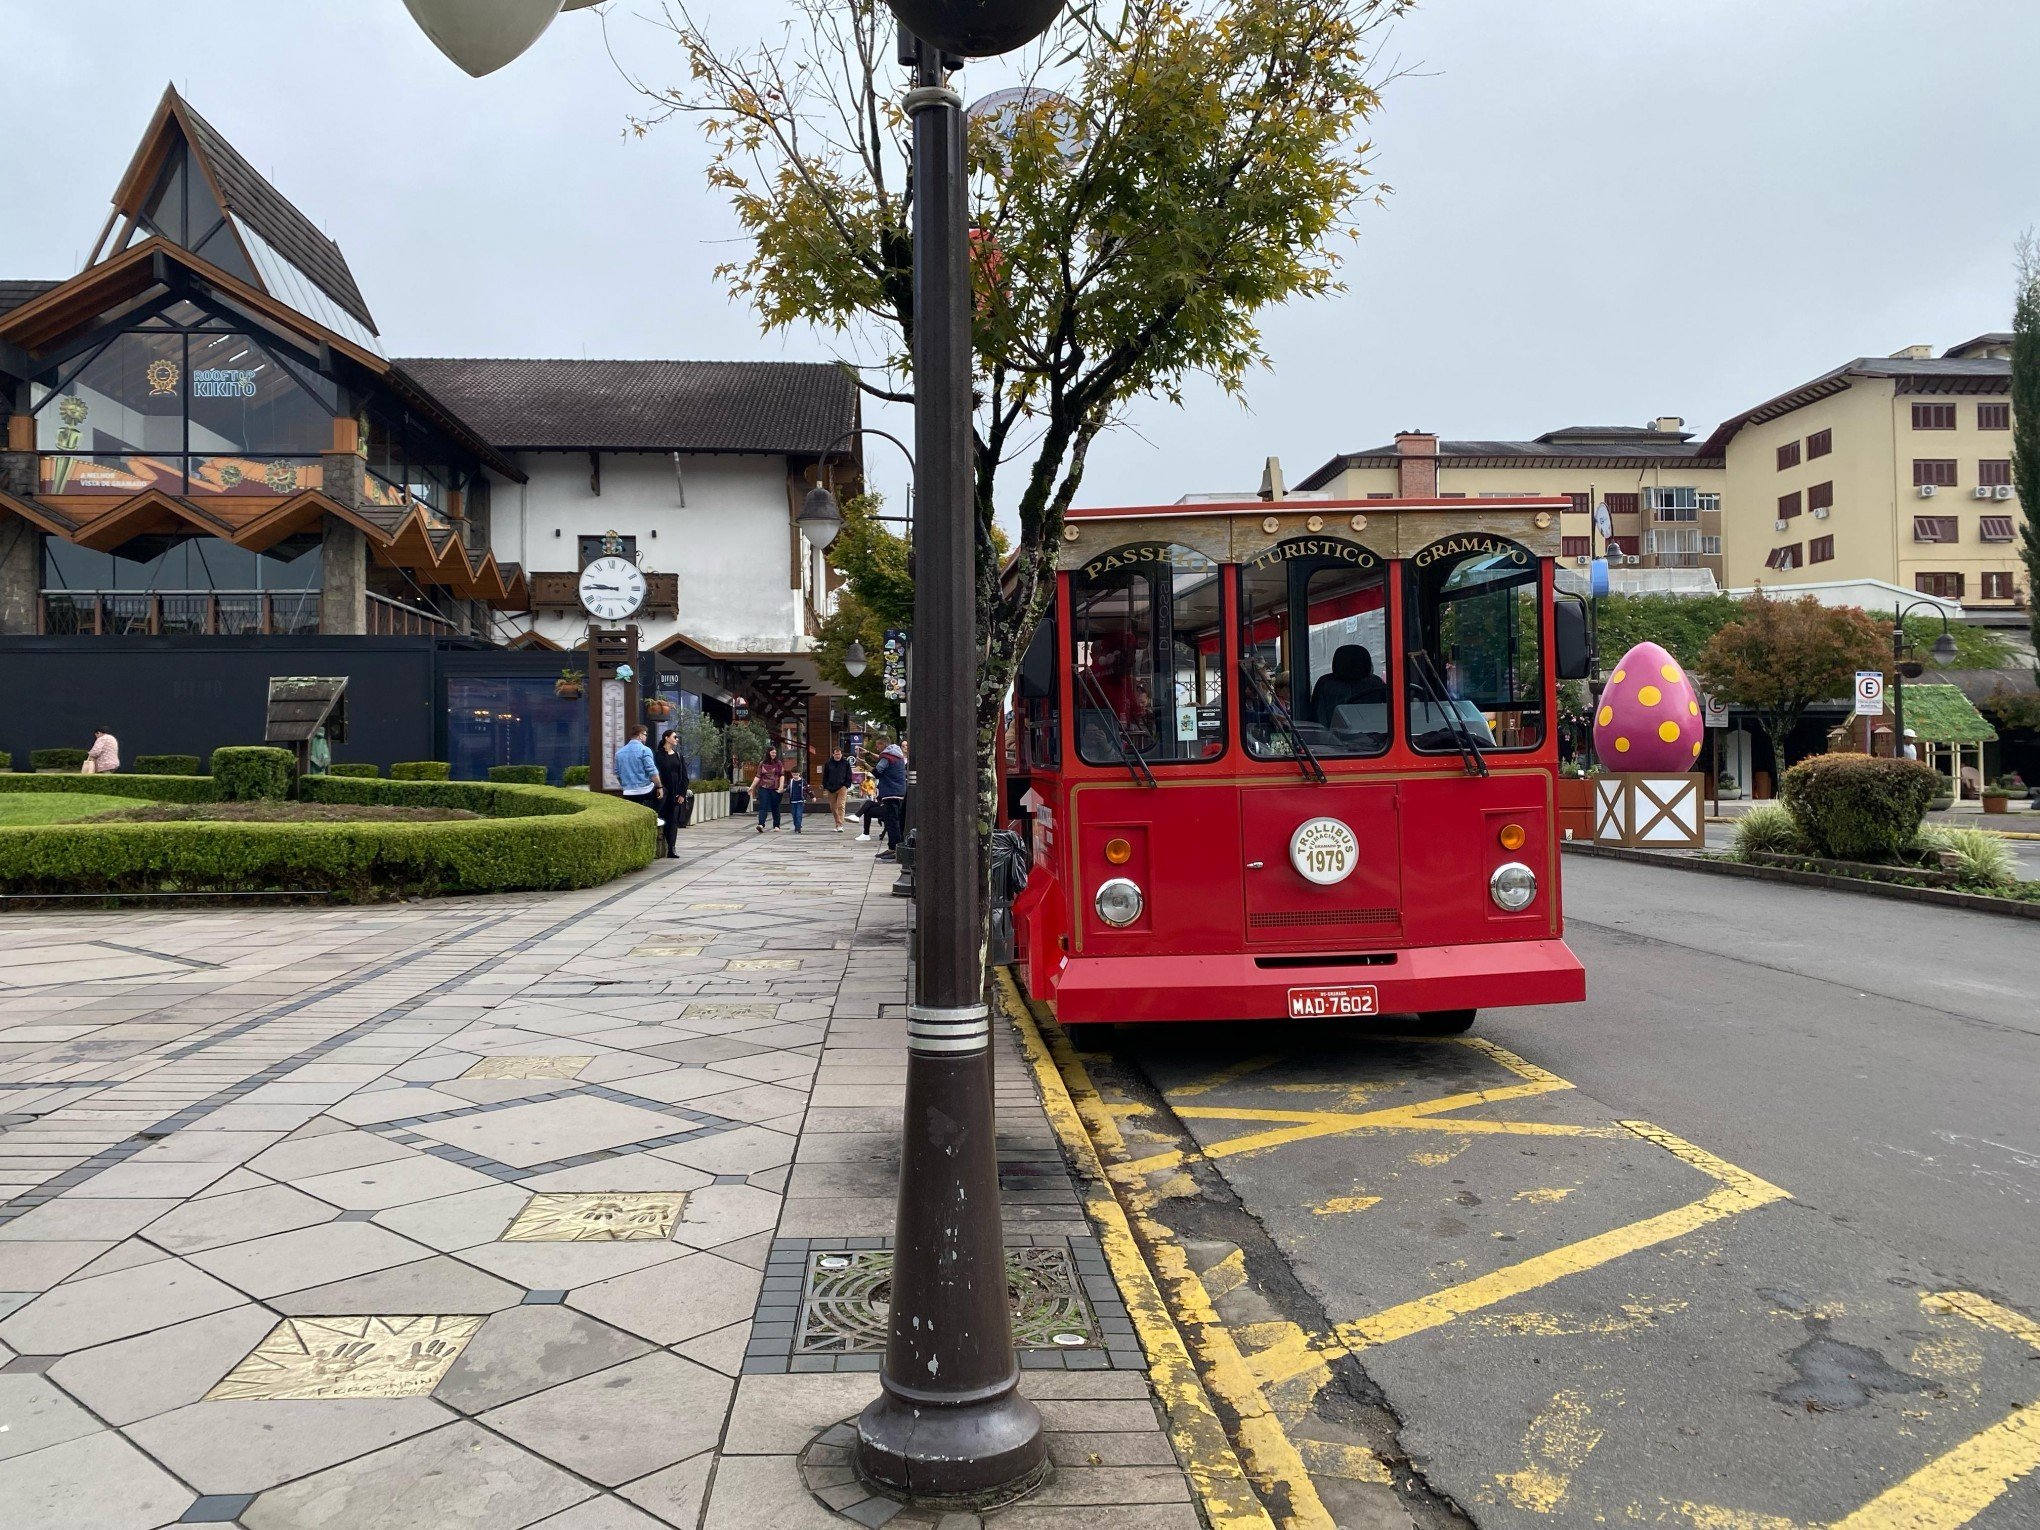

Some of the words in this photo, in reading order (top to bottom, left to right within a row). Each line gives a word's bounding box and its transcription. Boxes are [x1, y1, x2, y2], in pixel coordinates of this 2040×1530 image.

[193, 370, 256, 381] ROOFTOP
[193, 382, 256, 397] KIKITO
[1084, 547, 1209, 581] PASSEIO
[1252, 540, 1374, 571] TURISTICO
[1415, 537, 1528, 567] GRAMADO
[660, 674, 679, 683] DIVINO
[1865, 682, 1874, 695] E
[1298, 824, 1353, 854] TROLLIBUS
[1306, 850, 1345, 873] 1979
